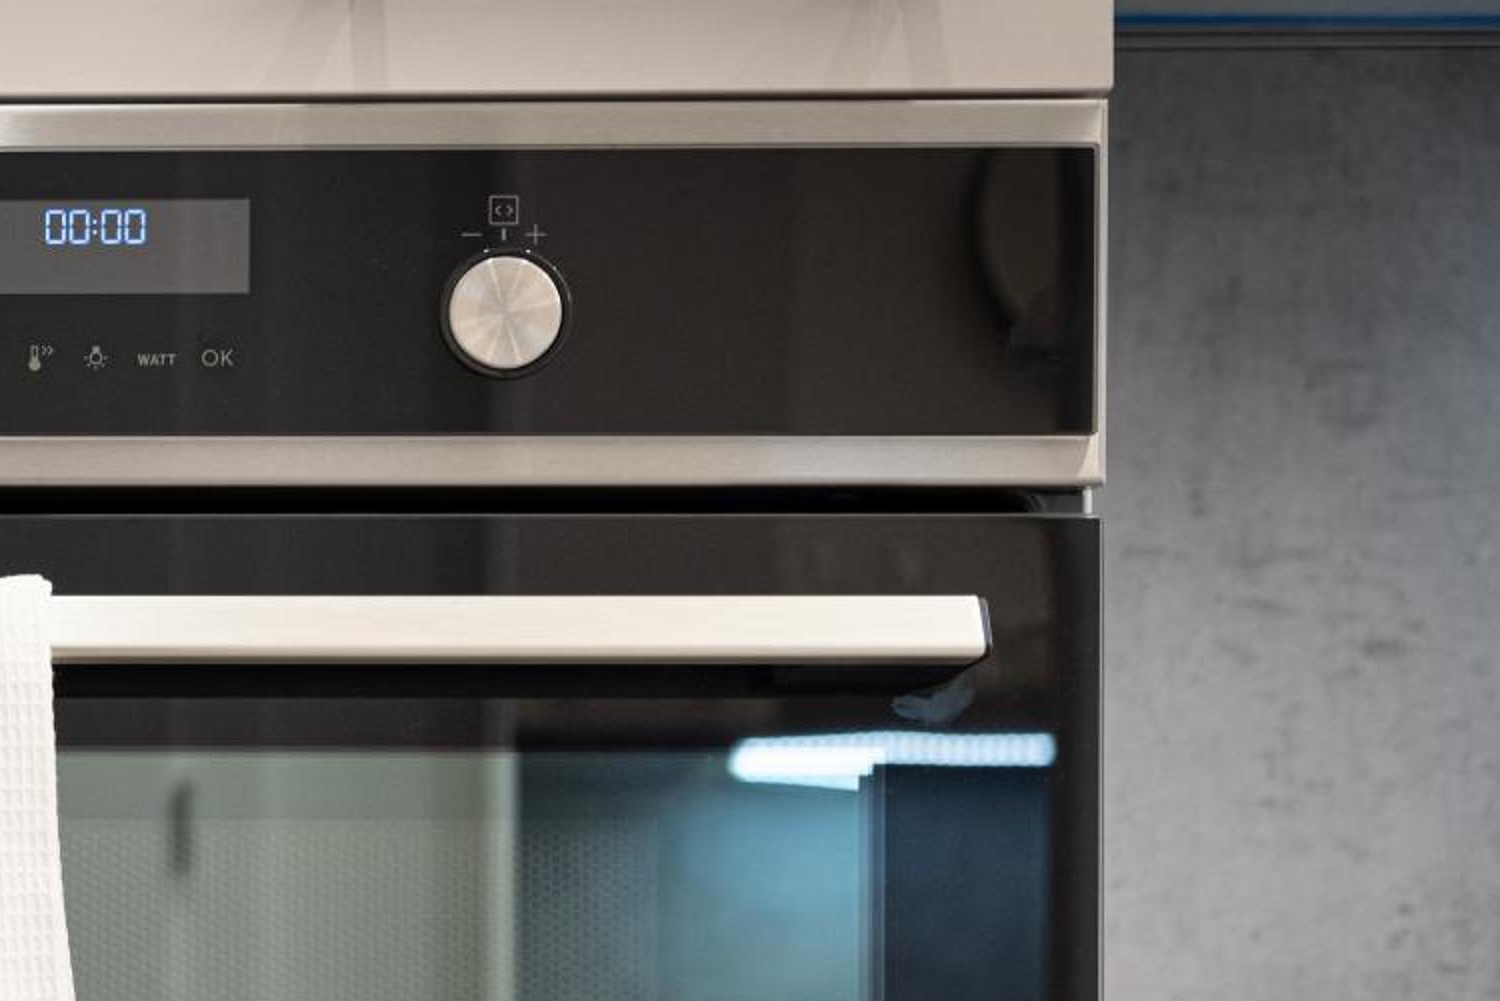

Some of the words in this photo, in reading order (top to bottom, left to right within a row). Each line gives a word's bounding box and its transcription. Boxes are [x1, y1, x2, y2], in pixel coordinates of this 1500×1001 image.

[45, 208, 147, 245] 00:00
[137, 352, 177, 366] WATT
[201, 349, 234, 367] OK
